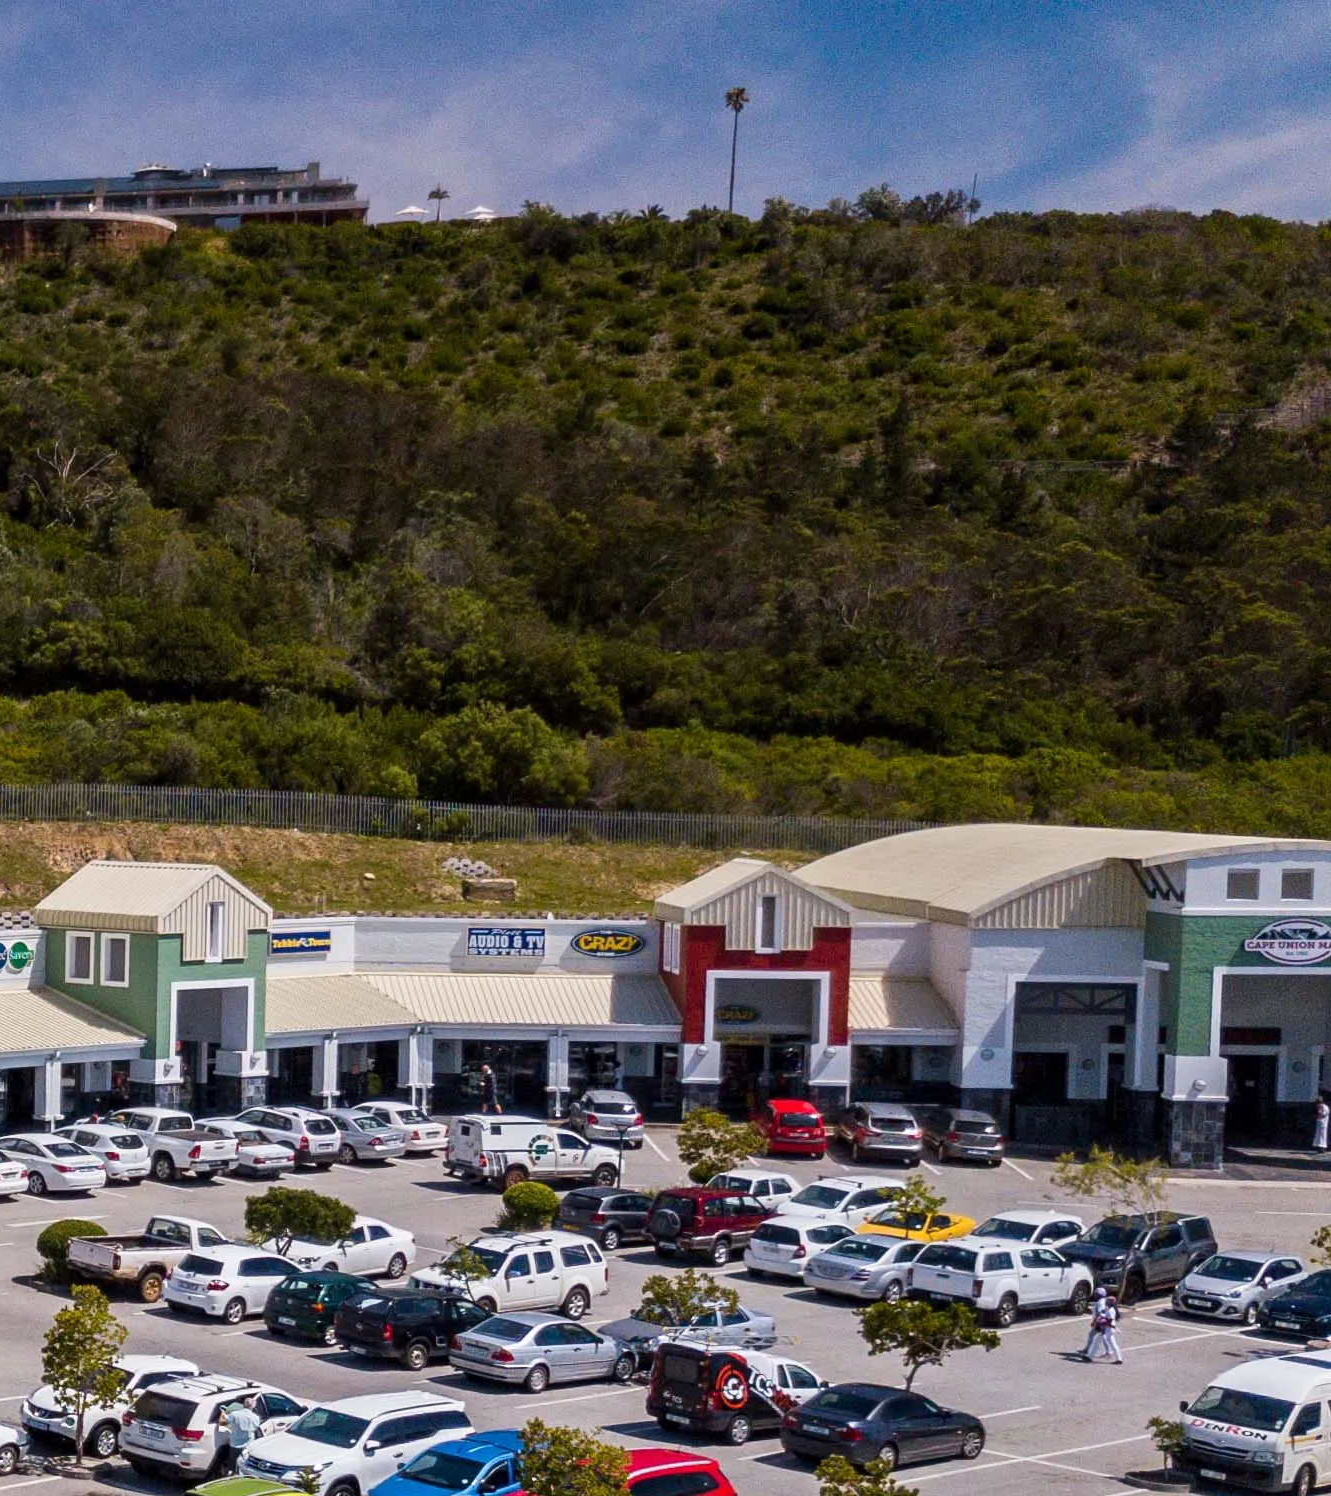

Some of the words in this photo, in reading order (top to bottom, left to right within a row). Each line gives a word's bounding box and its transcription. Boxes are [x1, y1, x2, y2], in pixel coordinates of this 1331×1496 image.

[469, 935, 509, 948] AUDIO
[513, 935, 523, 948] &
[526, 935, 544, 948] TV
[579, 935, 637, 951] CRAZY
[1247, 941, 1276, 949] CAPE
[1279, 941, 1315, 949] UNION
[1319, 941, 1331, 949] MA
[469, 947, 544, 956] SYSTEMS
